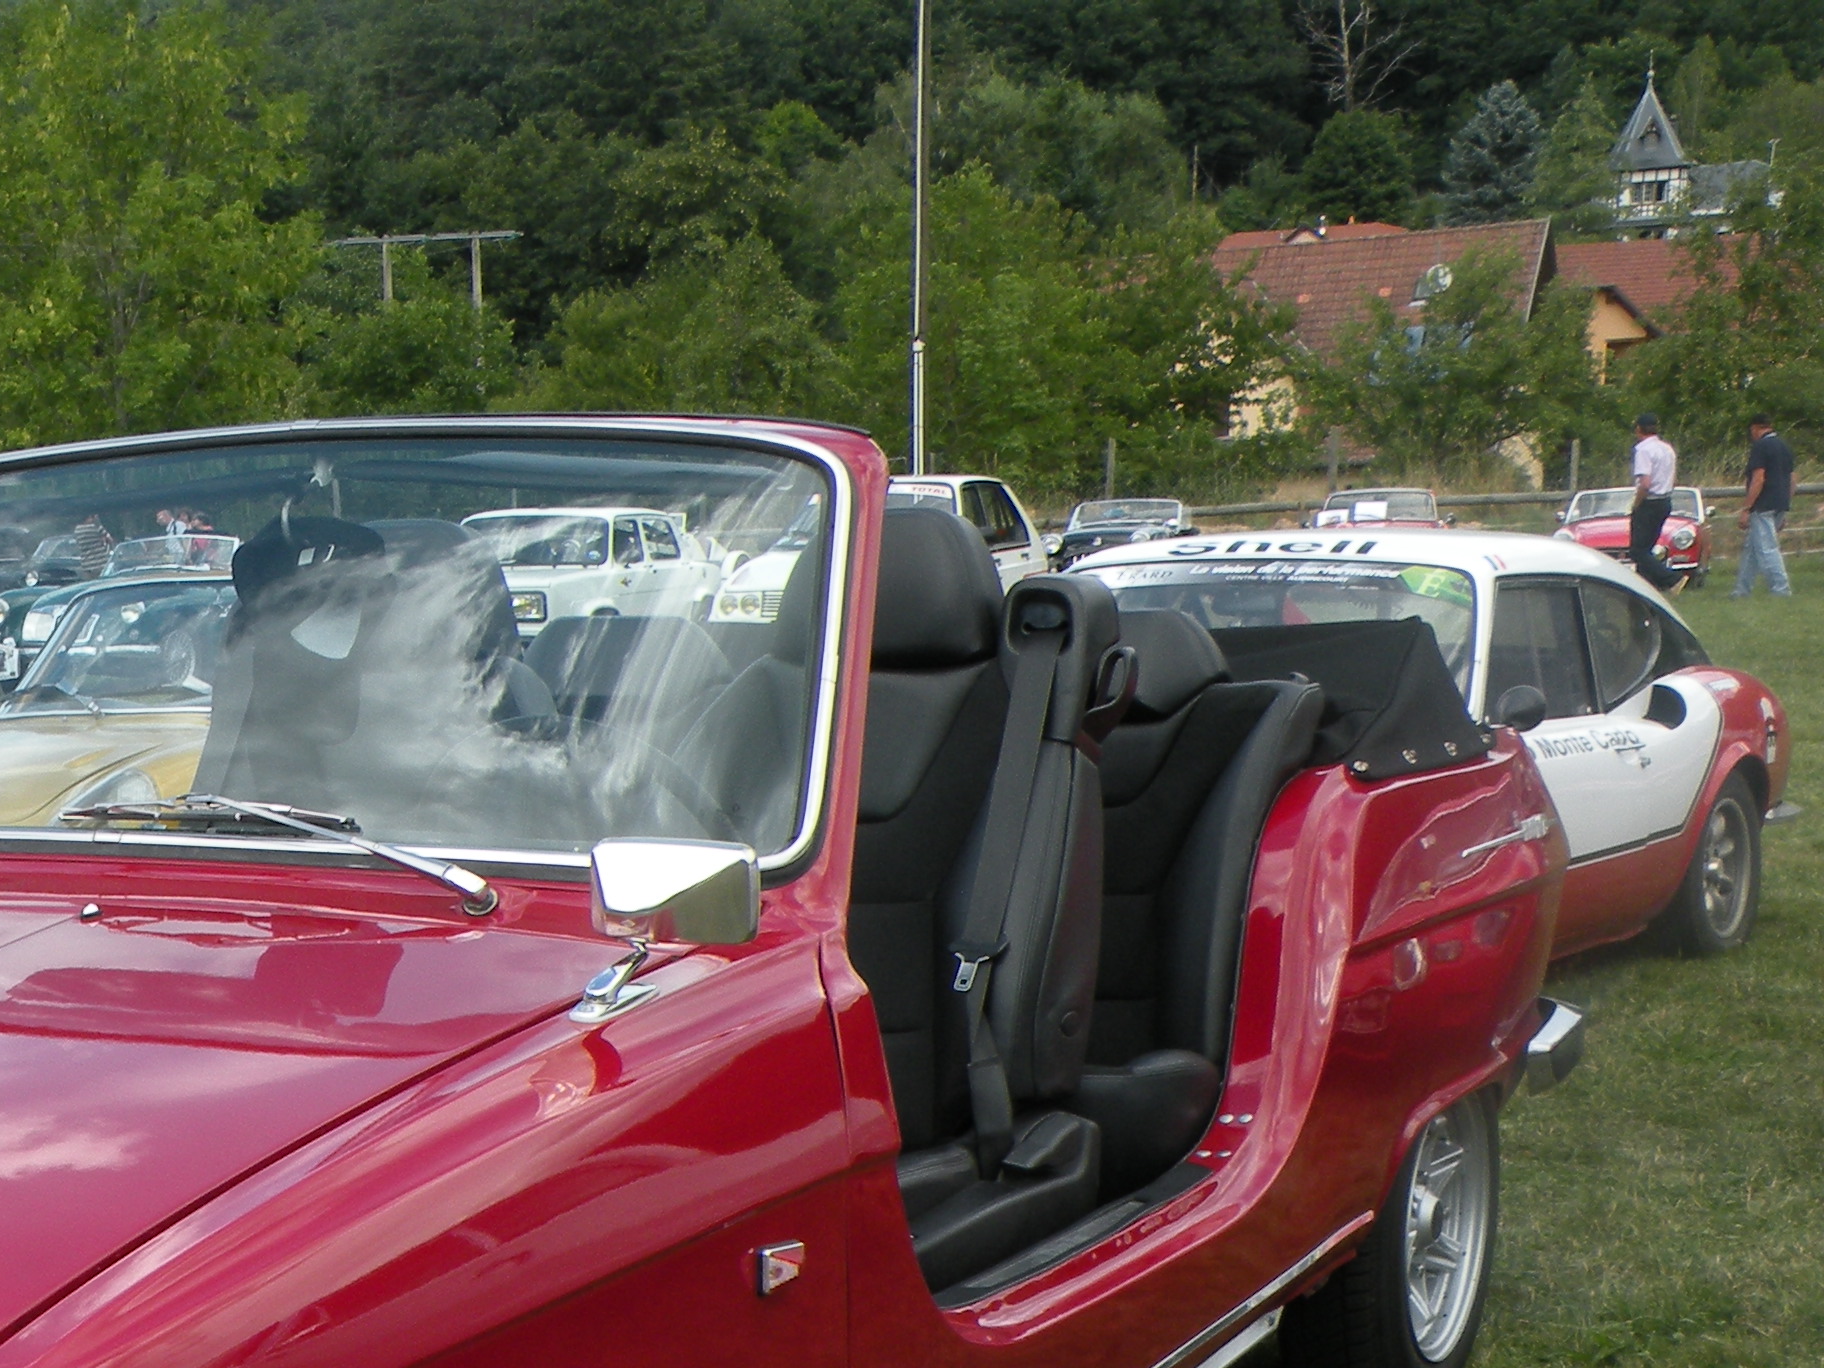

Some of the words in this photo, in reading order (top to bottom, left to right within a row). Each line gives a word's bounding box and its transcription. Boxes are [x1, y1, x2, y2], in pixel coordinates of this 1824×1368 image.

[912, 486, 946, 494] TOTAL
[1168, 540, 1378, 556] Shell
[1189, 565, 1210, 574] La
[1211, 565, 1256, 575] vision
[1295, 565, 1402, 580] performance
[1533, 734, 1594, 759] Monte
